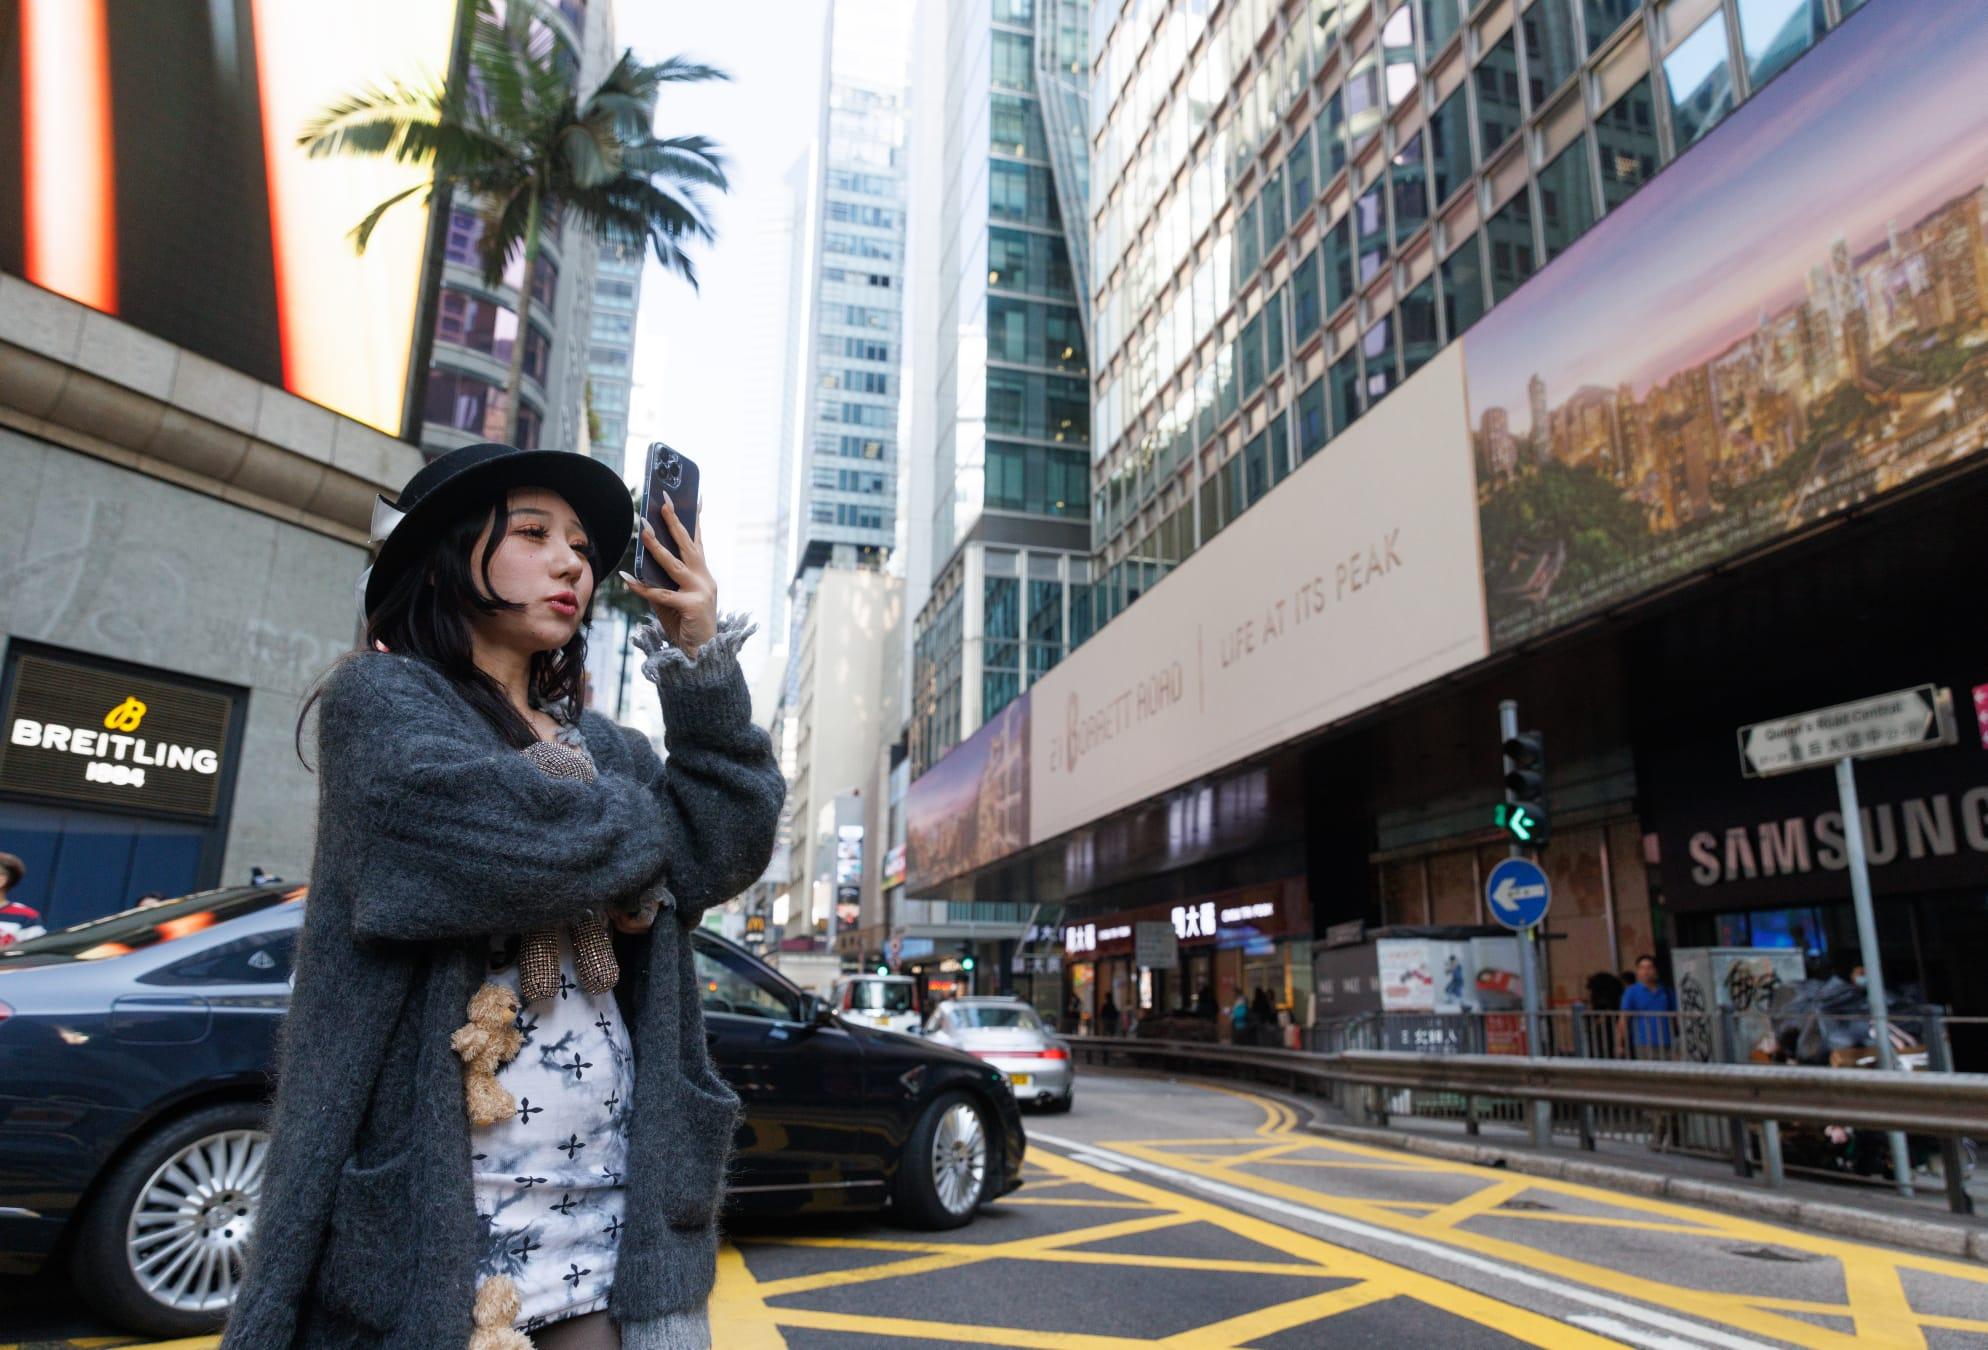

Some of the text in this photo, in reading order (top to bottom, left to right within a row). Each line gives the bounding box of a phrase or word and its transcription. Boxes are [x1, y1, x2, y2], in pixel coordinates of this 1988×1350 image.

[1220, 528, 1403, 668] LIFE AT ITS PEAK
[1137, 661, 1183, 722] ROAD
[1816, 713, 1850, 730] Road
[1852, 702, 1903, 723] Central
[11, 718, 219, 774] BREITLING
[1689, 787, 1988, 886] SAMSUNG
